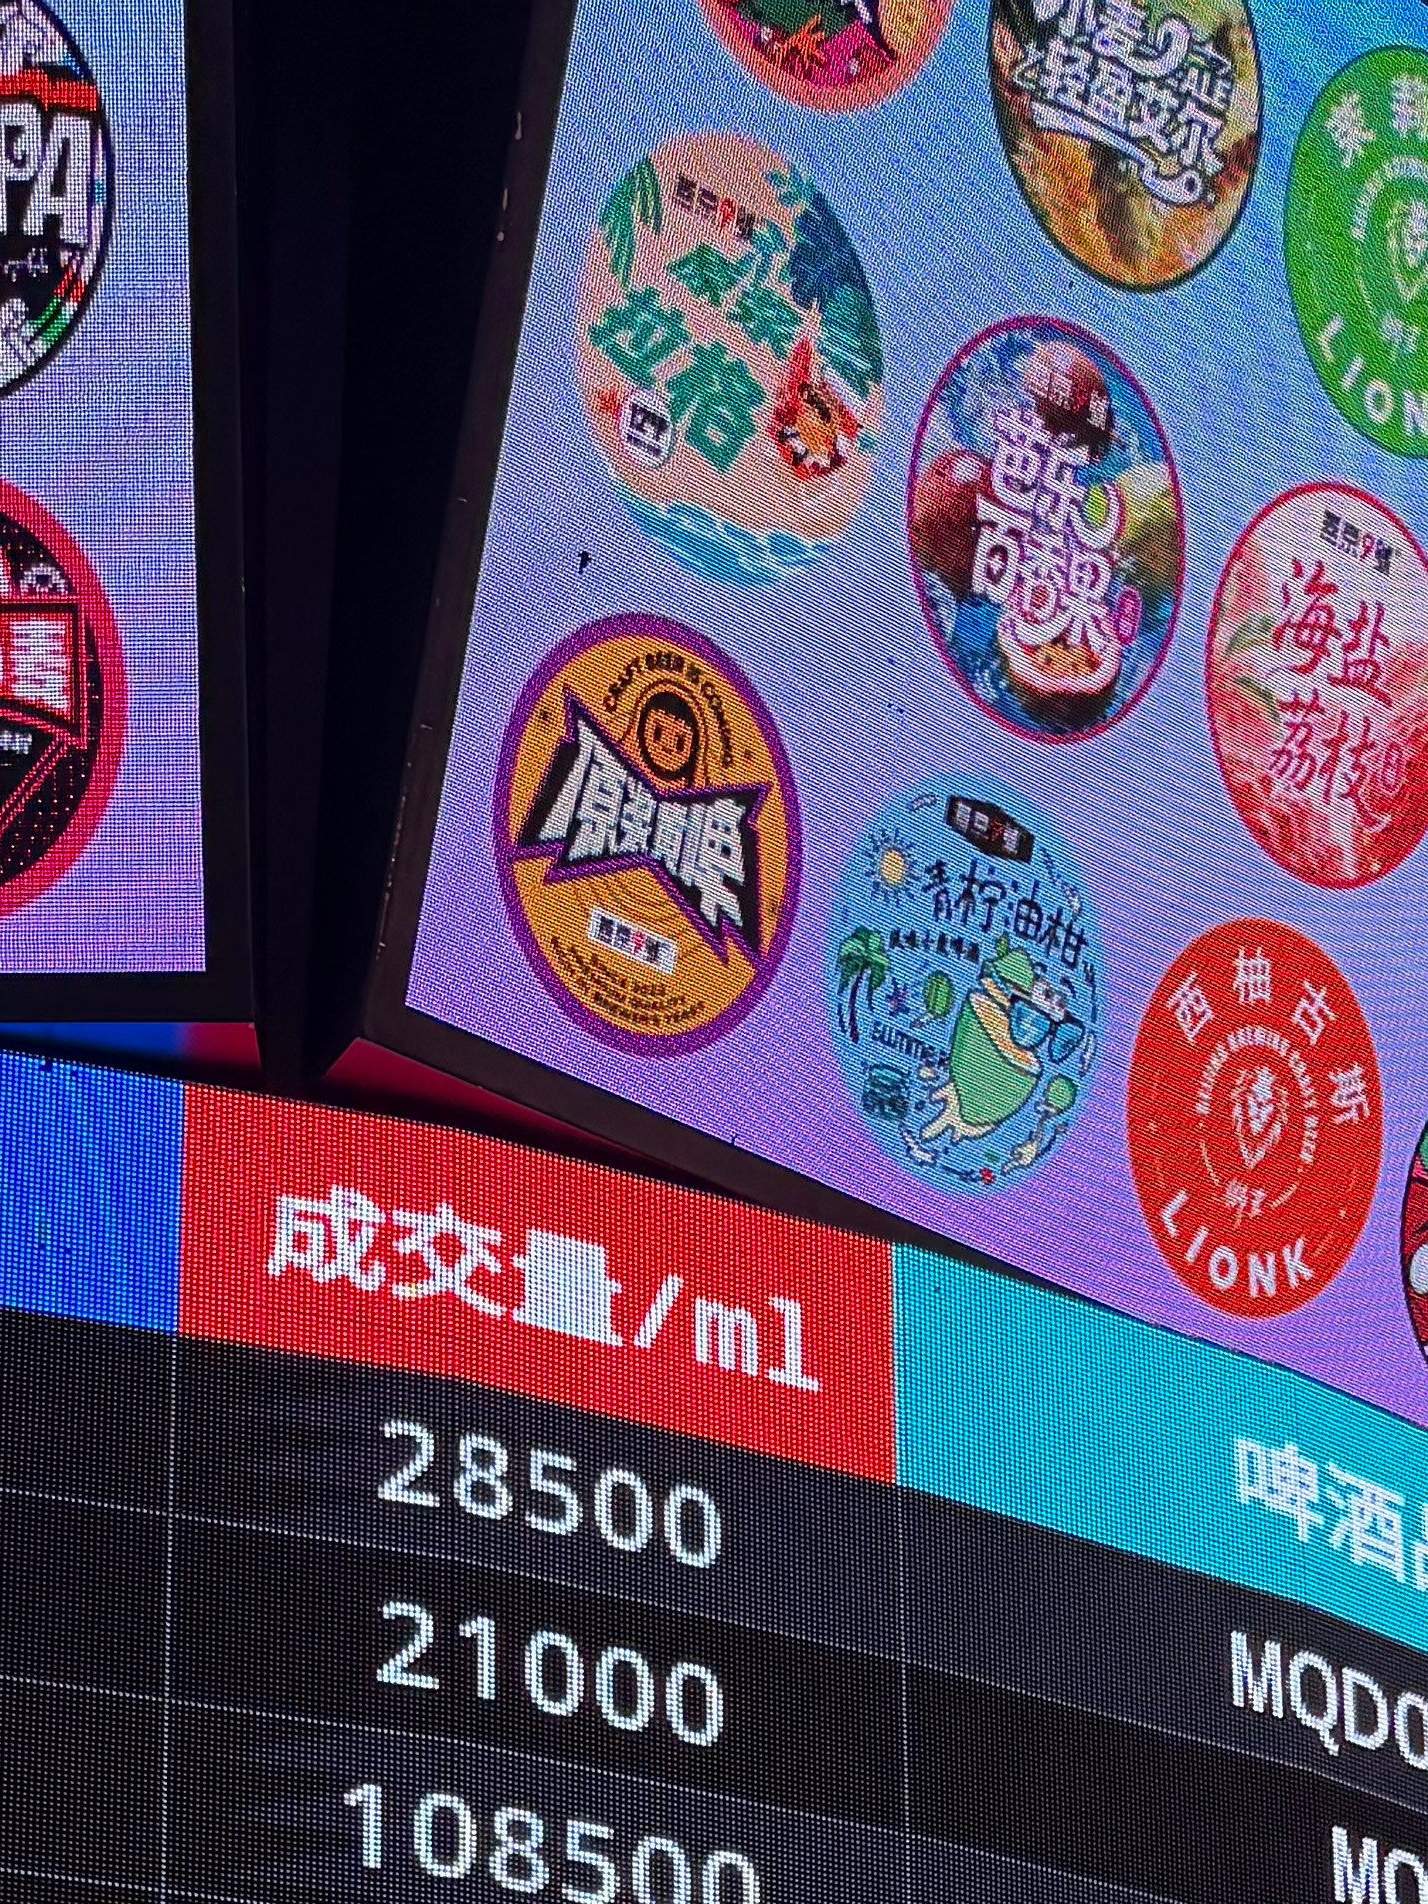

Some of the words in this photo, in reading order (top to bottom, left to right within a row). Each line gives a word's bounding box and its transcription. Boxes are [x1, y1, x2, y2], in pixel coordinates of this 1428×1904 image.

[1271, 558, 1390, 703] 海盐
[1271, 692, 1392, 832] 荔枝
[920, 864, 1086, 968] 青柠油柑
[1167, 947, 1370, 1125] 西柚古斯
[268, 1186, 819, 1391] 成交量/ml
[1161, 1190, 1314, 1297] LIONK
[378, 1420, 722, 1568] 28500
[376, 1602, 724, 1747] 21000
